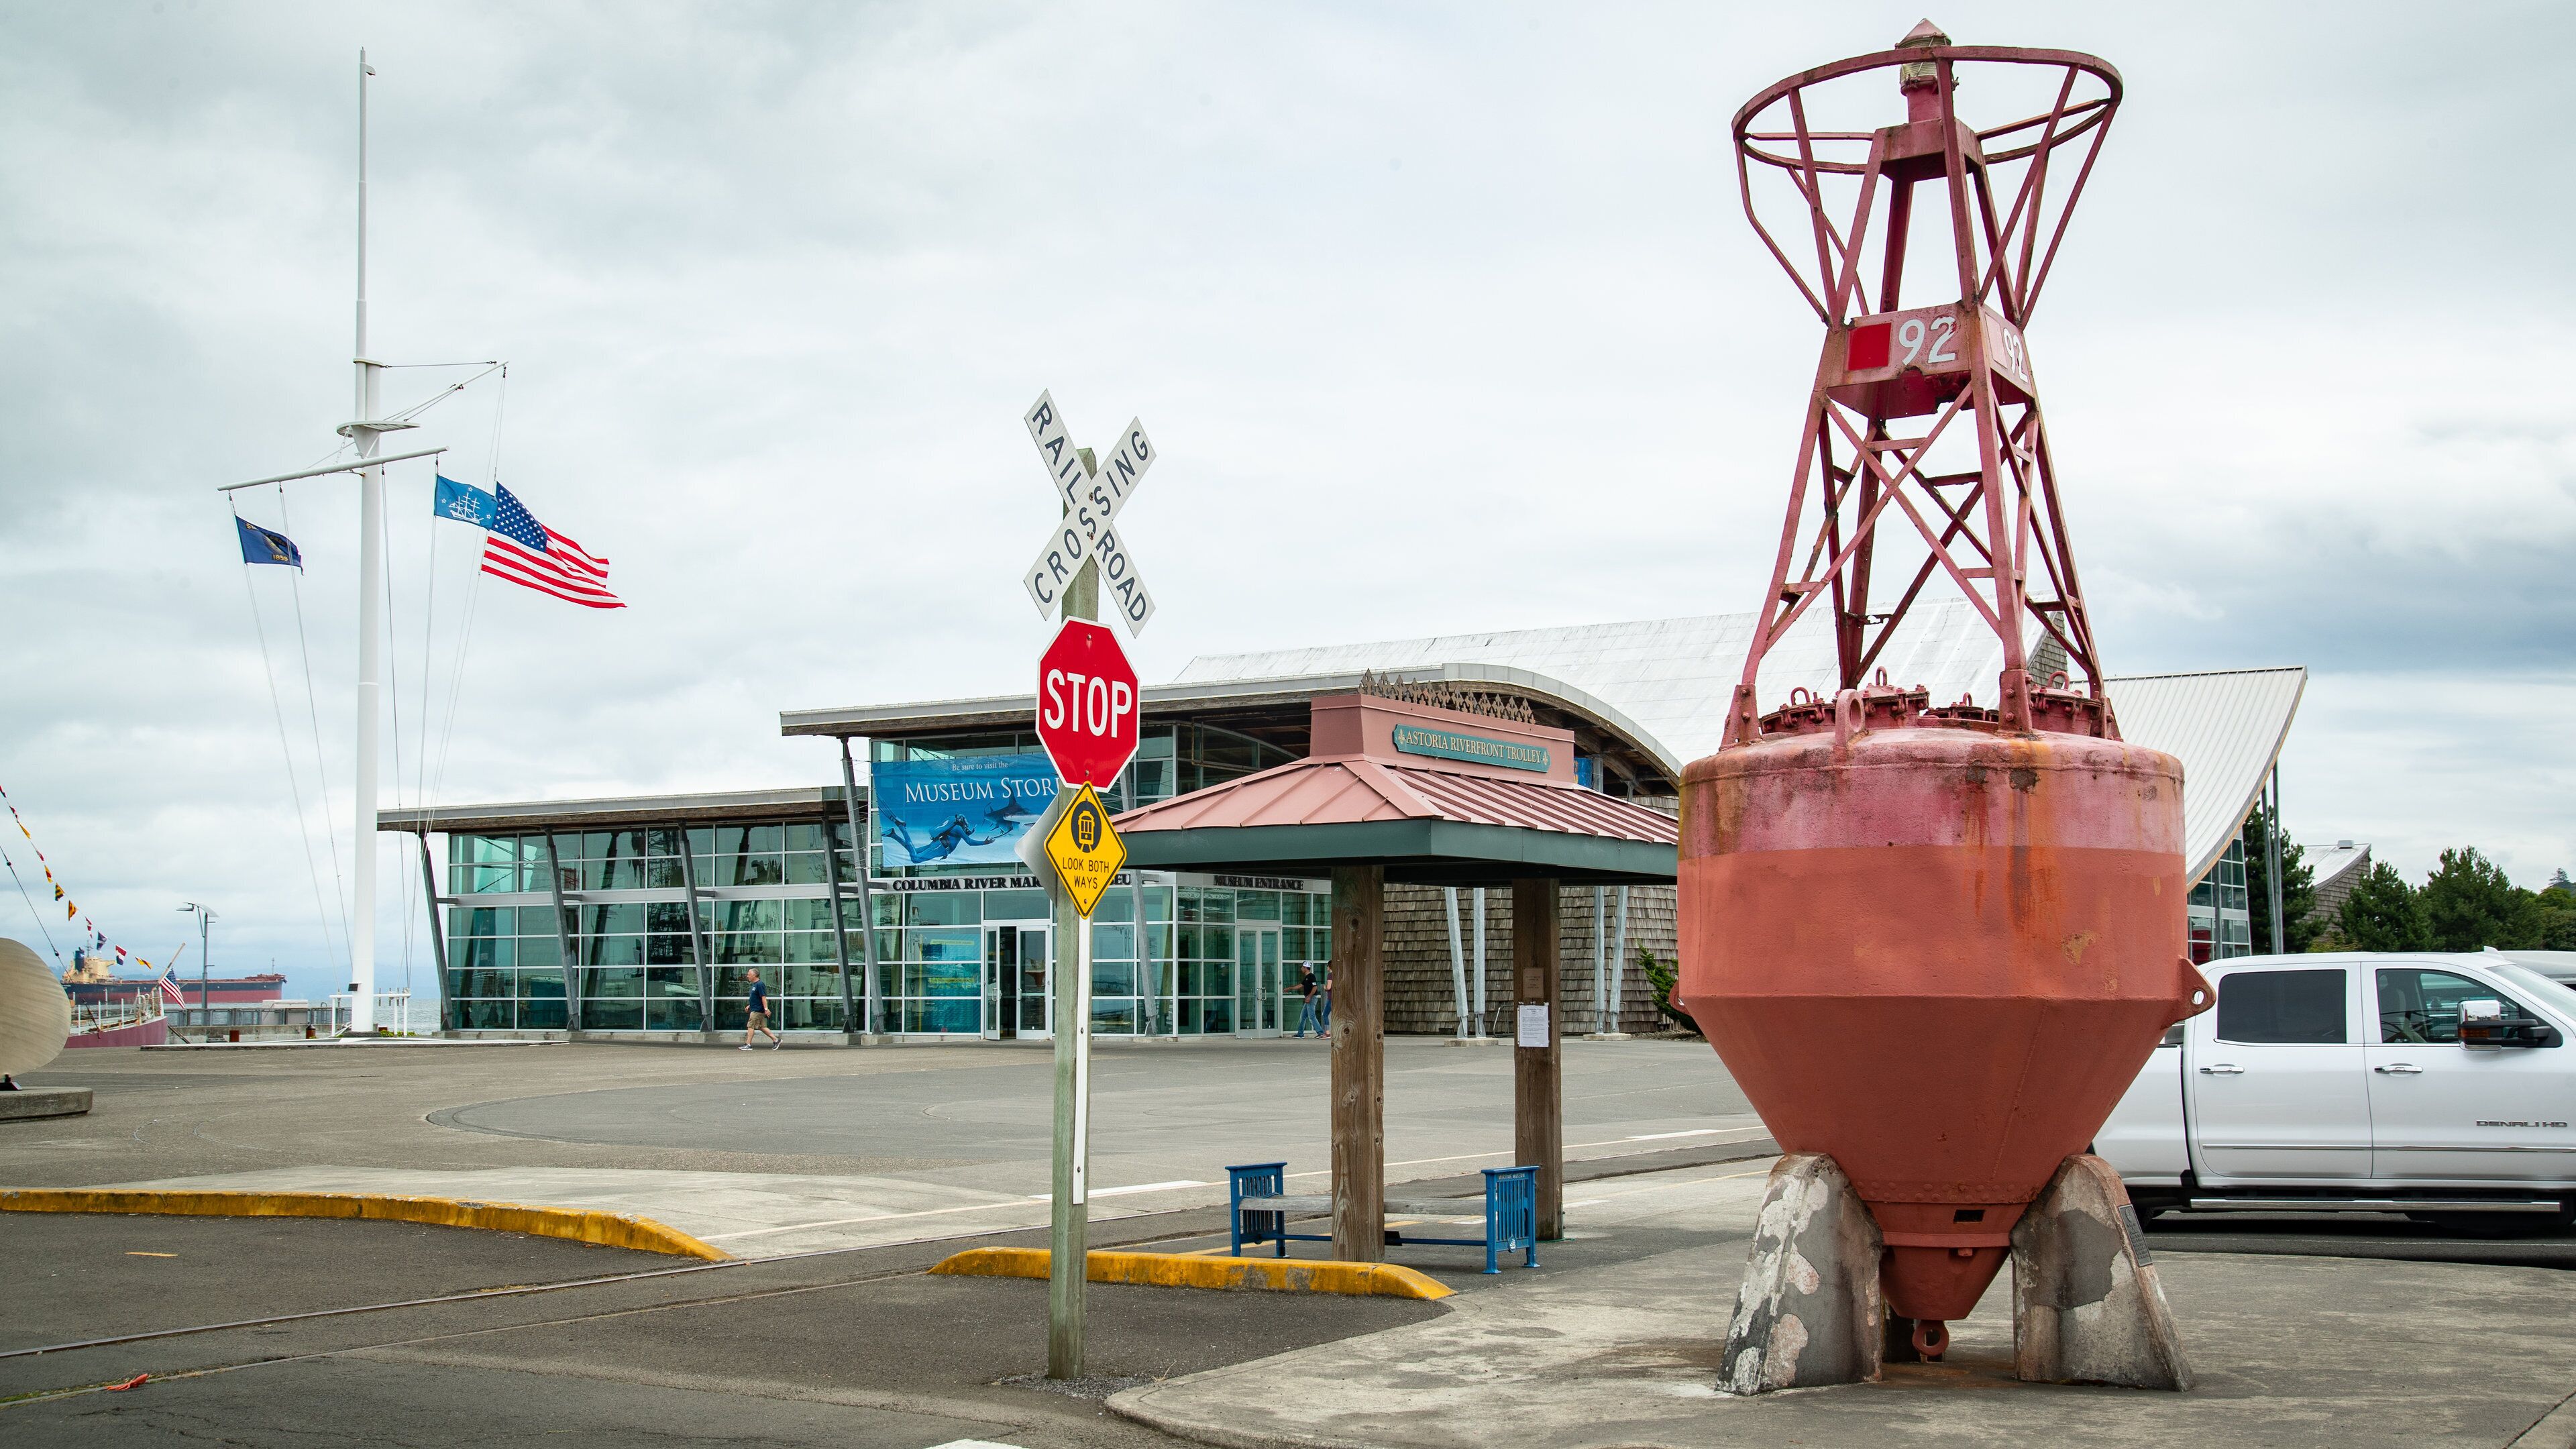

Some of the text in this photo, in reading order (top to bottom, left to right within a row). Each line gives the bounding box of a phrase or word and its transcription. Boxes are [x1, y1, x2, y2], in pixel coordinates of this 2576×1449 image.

[1898, 316, 1957, 365] 92
[2003, 328, 2029, 383] 92
[1032, 401, 1081, 504] RAIL
[1034, 431, 1148, 603] CROSSING
[1096, 530, 1146, 621] ROAD
[1044, 669, 1132, 738] STOP
[1406, 731, 1542, 764] ASTORIA RIVERFRONT TROLLEY
[906, 782, 994, 803] MUSEUM
[893, 879, 961, 891] COLUMBIA
[963, 877, 1007, 889] RIVER
[1063, 857, 1110, 873] LOOK BOTH
[1074, 875, 1098, 890] WAYS
[1214, 875, 1304, 890] MUSEUM ENTRANCE
